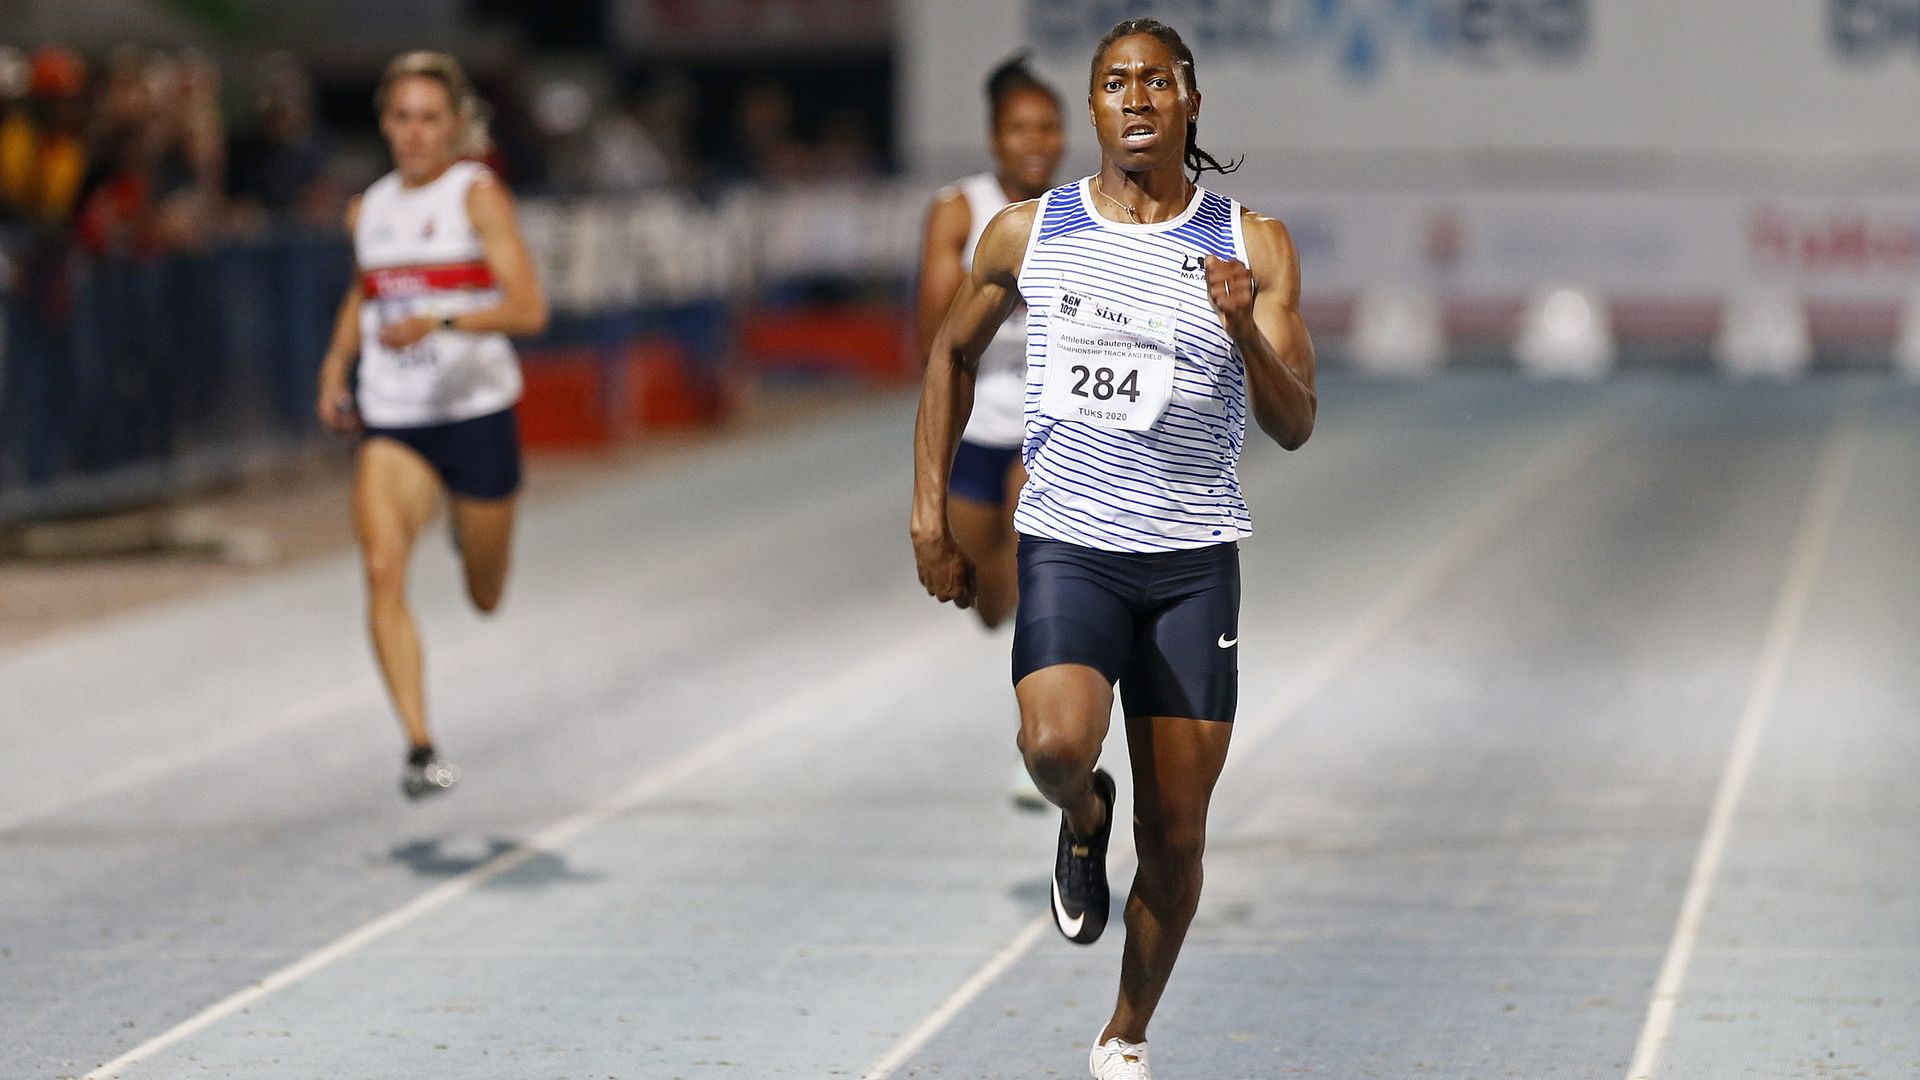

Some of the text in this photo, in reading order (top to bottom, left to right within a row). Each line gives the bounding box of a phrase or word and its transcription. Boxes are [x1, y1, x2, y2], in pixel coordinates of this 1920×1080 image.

[1062, 294, 1081, 307] AGN
[1060, 303, 1078, 317] 1020
[1061, 334, 1095, 346] Athletics
[1097, 338, 1158, 351] Gauteng-North
[1056, 343, 1163, 361] CHAMPIONSHIP TRACK AND FIELD
[1071, 364, 1140, 402] 284
[1078, 407, 1127, 421] TUKS 2020
